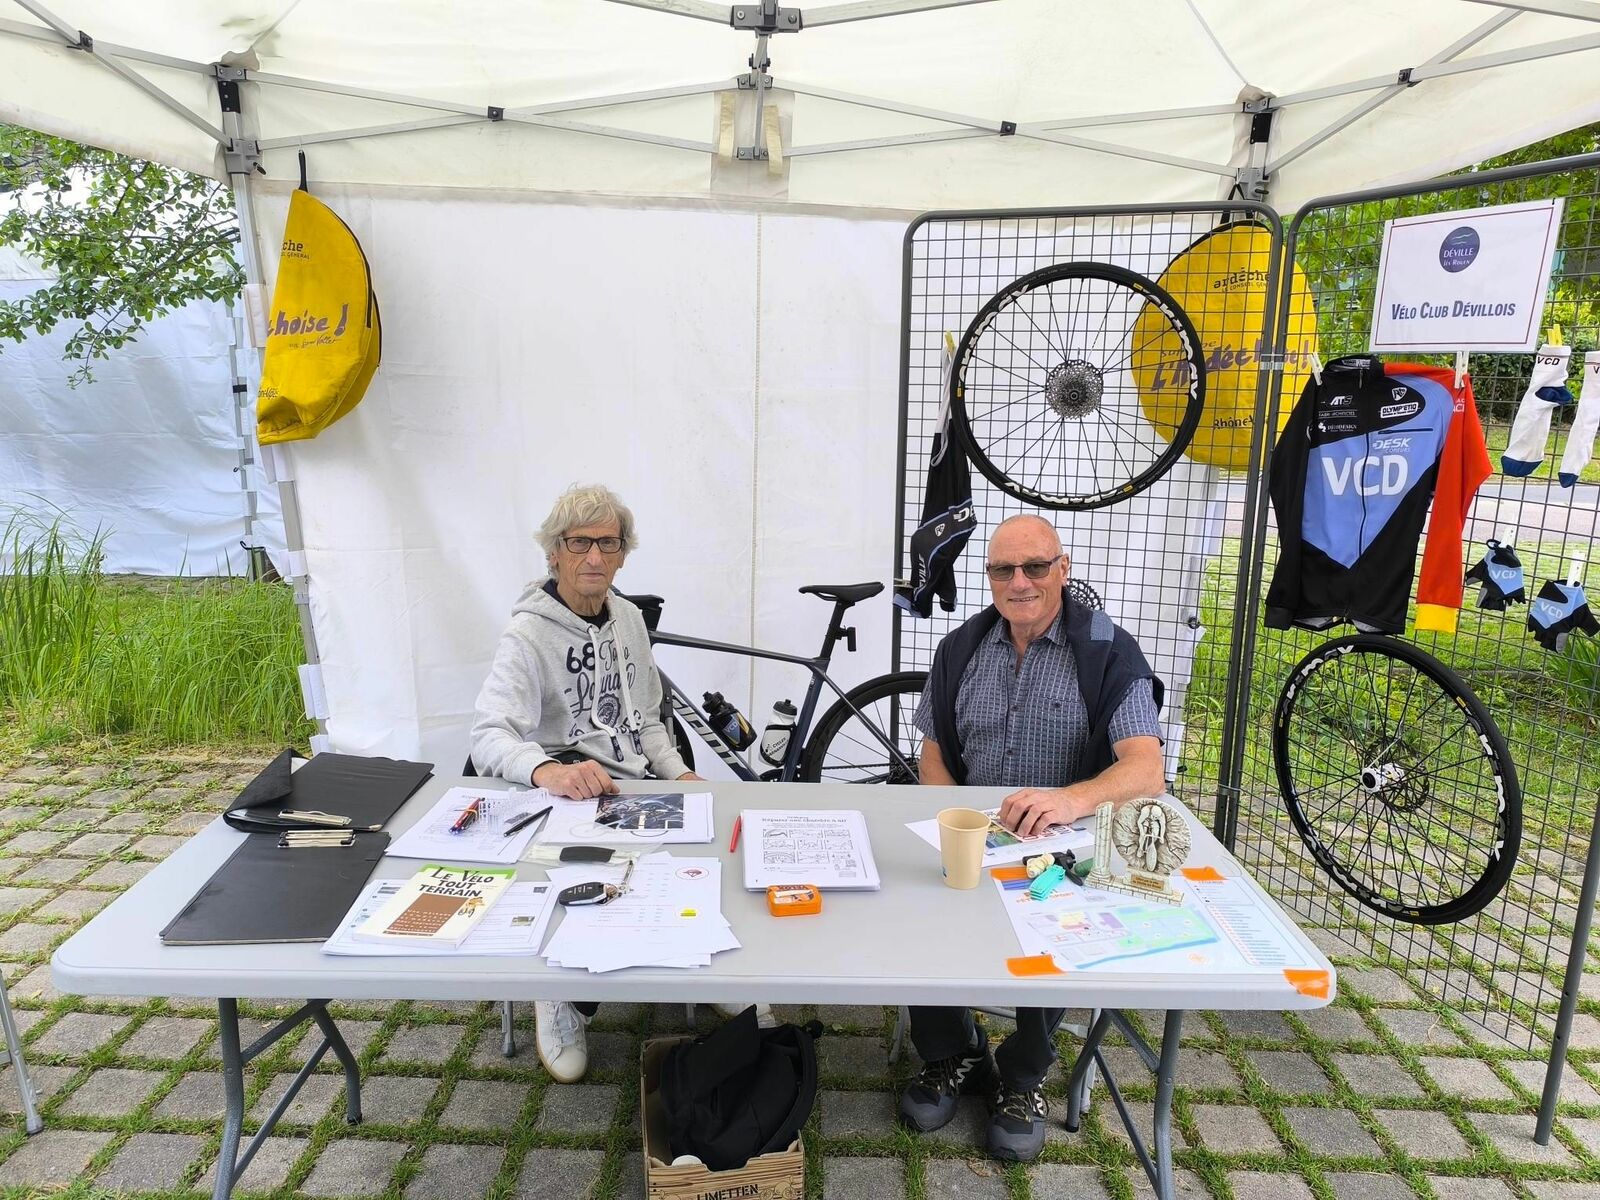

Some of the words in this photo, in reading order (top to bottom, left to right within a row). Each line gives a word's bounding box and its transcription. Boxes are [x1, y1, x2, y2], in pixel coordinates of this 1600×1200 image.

[1537, 356, 1560, 366] VCD
[1373, 438, 1412, 449] DESK
[1321, 454, 1409, 496] VCD
[1491, 569, 1517, 580] VCD
[1540, 601, 1563, 619] VCD
[566, 642, 596, 674] 68
[439, 879, 477, 889] TOUT
[419, 884, 482, 897] TERRAIN
